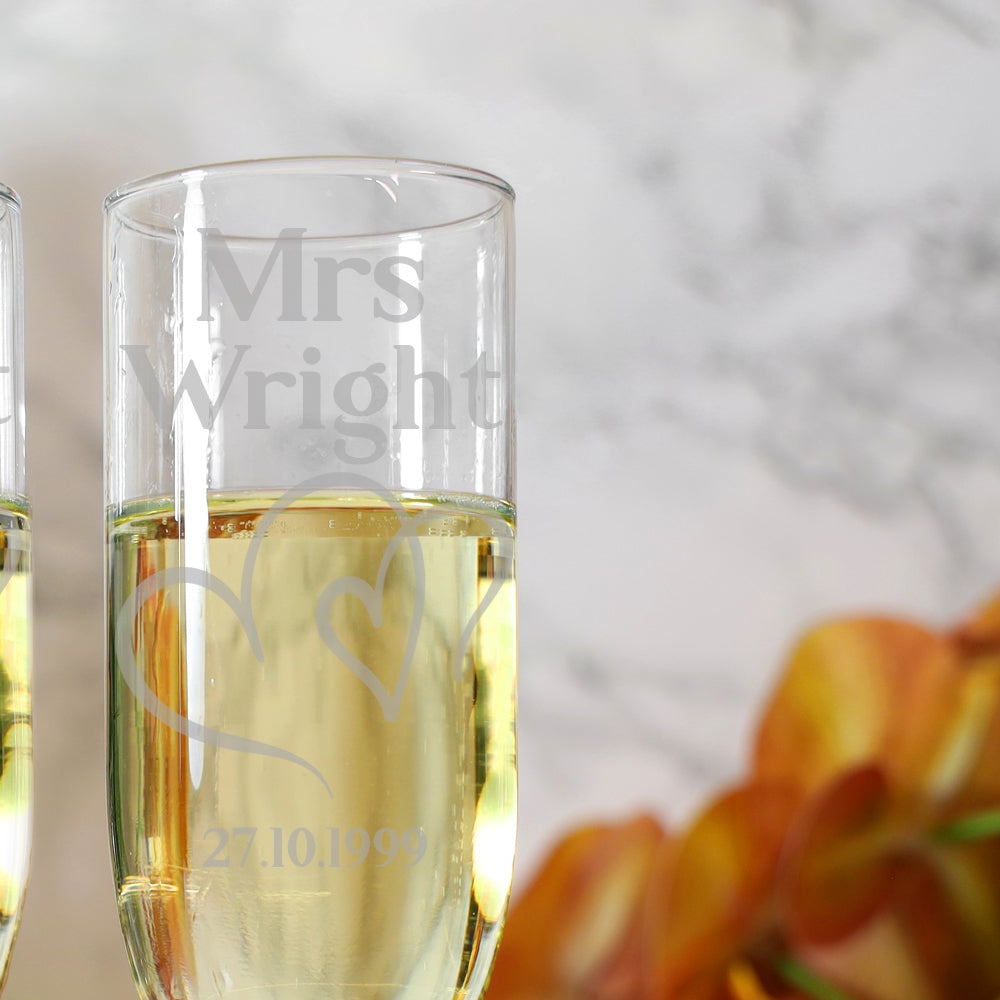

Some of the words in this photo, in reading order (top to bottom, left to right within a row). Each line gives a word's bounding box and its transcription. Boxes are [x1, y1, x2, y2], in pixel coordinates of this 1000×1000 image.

[196, 227, 425, 324] Mrs
[119, 344, 504, 465] Wright
[201, 826, 428, 868] 27.10.1999
